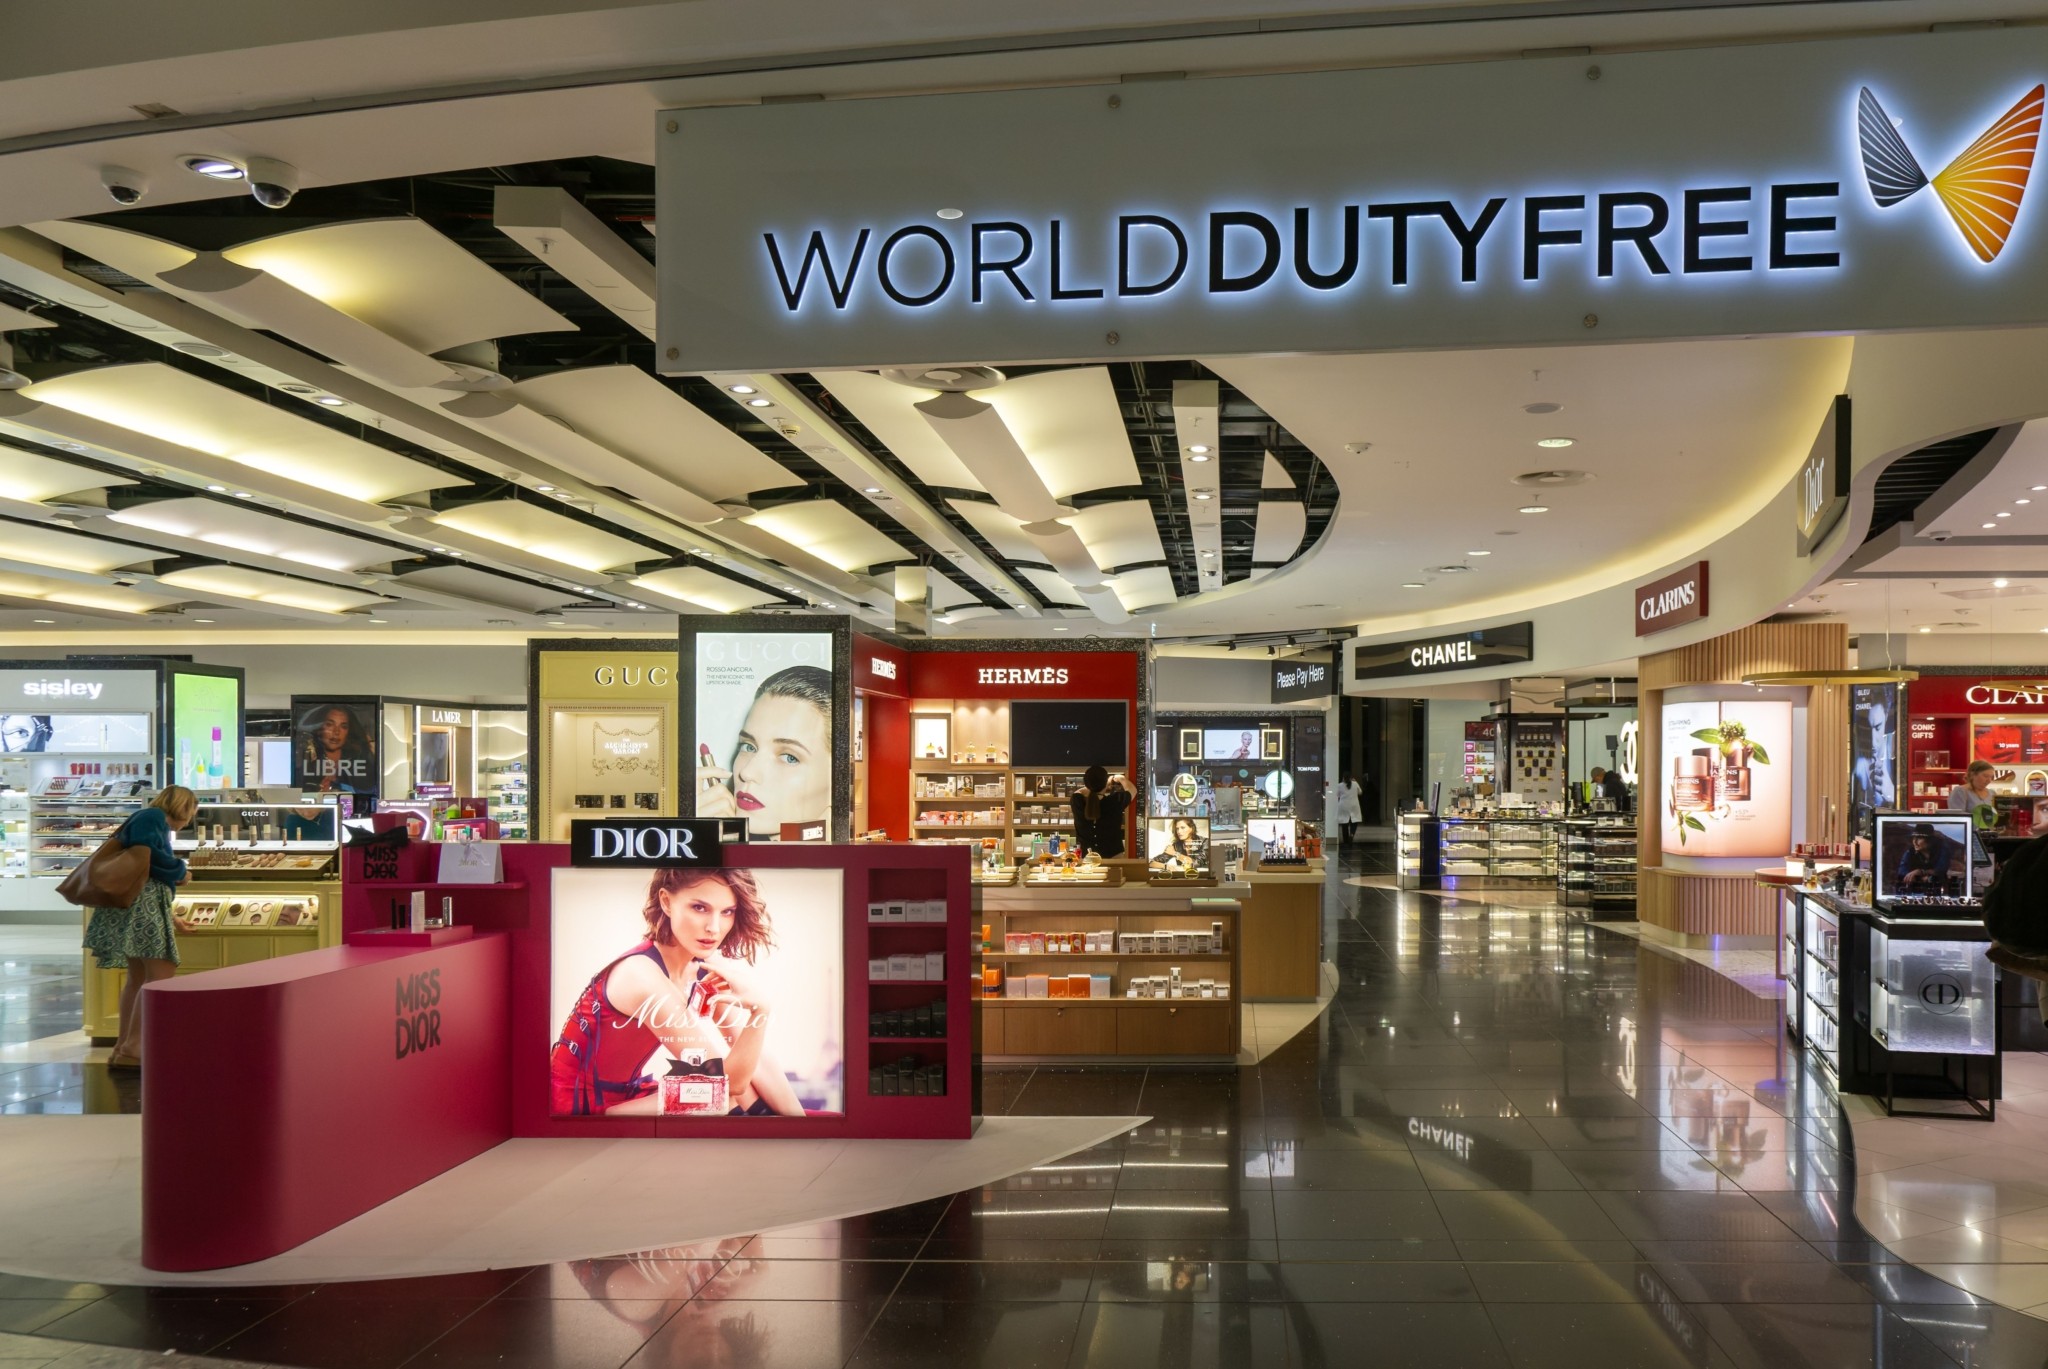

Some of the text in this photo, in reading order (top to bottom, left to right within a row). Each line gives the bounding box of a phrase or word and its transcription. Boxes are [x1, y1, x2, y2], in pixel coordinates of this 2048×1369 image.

[1804, 457, 1825, 531] Dior
[1640, 579, 1695, 621] CLARINS
[705, 640, 826, 662] GUCCI
[1410, 640, 1477, 667] CHANEL
[594, 666, 679, 686] GUC
[978, 666, 1069, 684] HERMÈS
[1276, 664, 1324, 689] Please Pay Here
[23, 678, 103, 700] sisley
[432, 709, 462, 724] LA MER
[1911, 731, 1934, 739] GIFTS
[303, 758, 367, 778] LIBRE
[589, 826, 699, 860] DIOR
[364, 846, 398, 863] MISS
[363, 862, 399, 880] DIOR
[1900, 895, 1983, 906] SAUVAGE
[395, 967, 441, 1017] MISS
[612, 992, 698, 1030] Miss
[395, 1009, 441, 1060] DIOR
